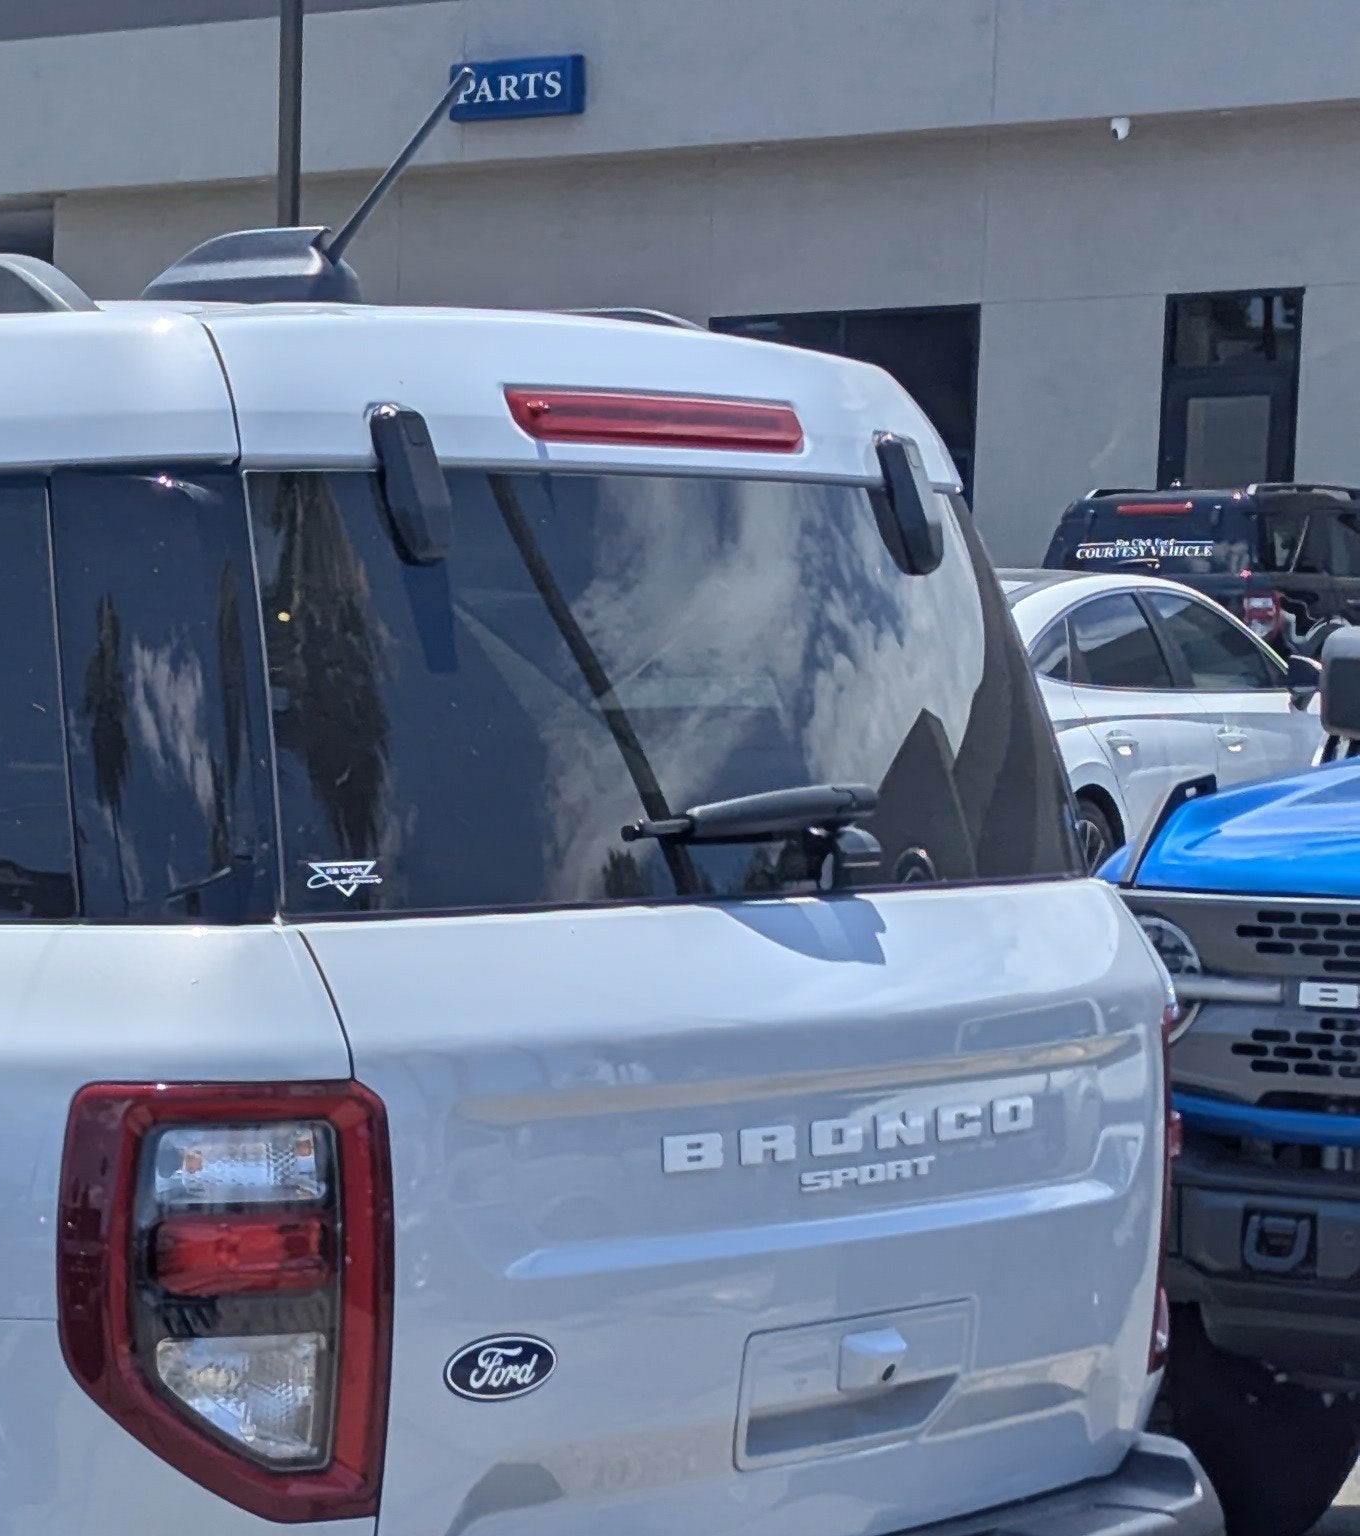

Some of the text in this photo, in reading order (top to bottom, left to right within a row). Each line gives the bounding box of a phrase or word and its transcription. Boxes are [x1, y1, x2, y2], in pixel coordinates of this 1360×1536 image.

[456, 70, 562, 105] PARTS
[1075, 544, 1214, 560] COURTESY VEHICLE
[662, 1095, 1034, 1175] BRONCO
[800, 1155, 936, 1193] SPORT
[469, 1345, 539, 1389] Ford
